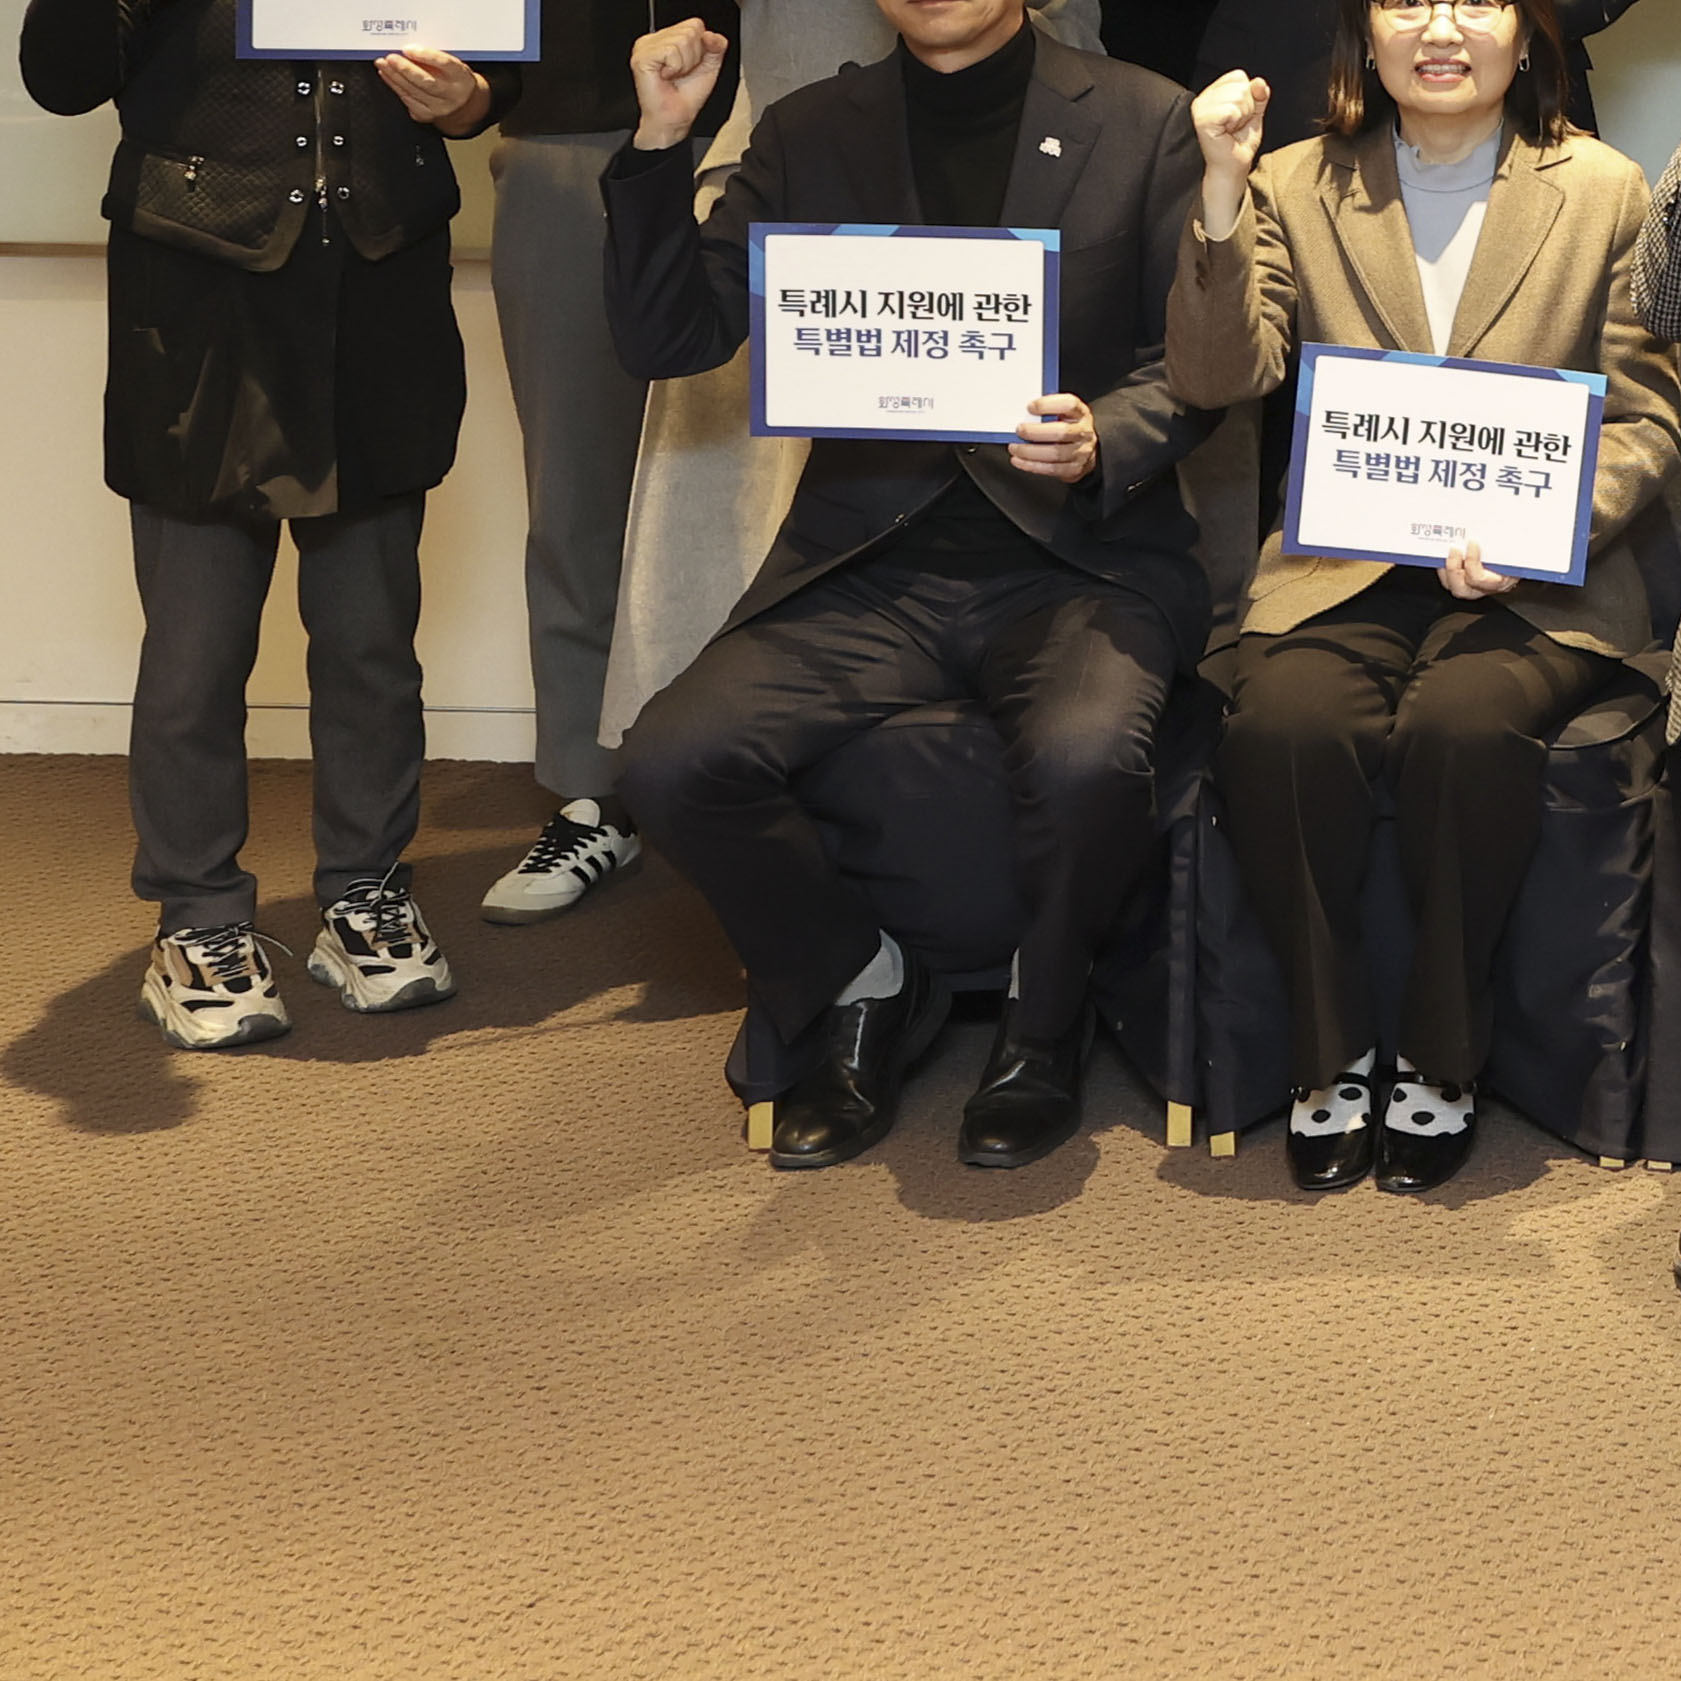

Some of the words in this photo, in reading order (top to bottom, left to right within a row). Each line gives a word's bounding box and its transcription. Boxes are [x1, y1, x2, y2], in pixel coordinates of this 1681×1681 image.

[778, 289, 866, 318] 특례시
[878, 291, 963, 321] 지원에
[973, 293, 1032, 322] 관한
[794, 328, 881, 357] 특별법
[891, 330, 948, 359] 제정
[959, 331, 1016, 360] 촉구
[1322, 411, 1409, 445] 특례시
[1418, 421, 1505, 455] 지원에
[1514, 431, 1571, 463] 관한
[1333, 450, 1420, 484] 특별법
[1428, 460, 1486, 491] 제정
[1496, 466, 1552, 498] 촉구
